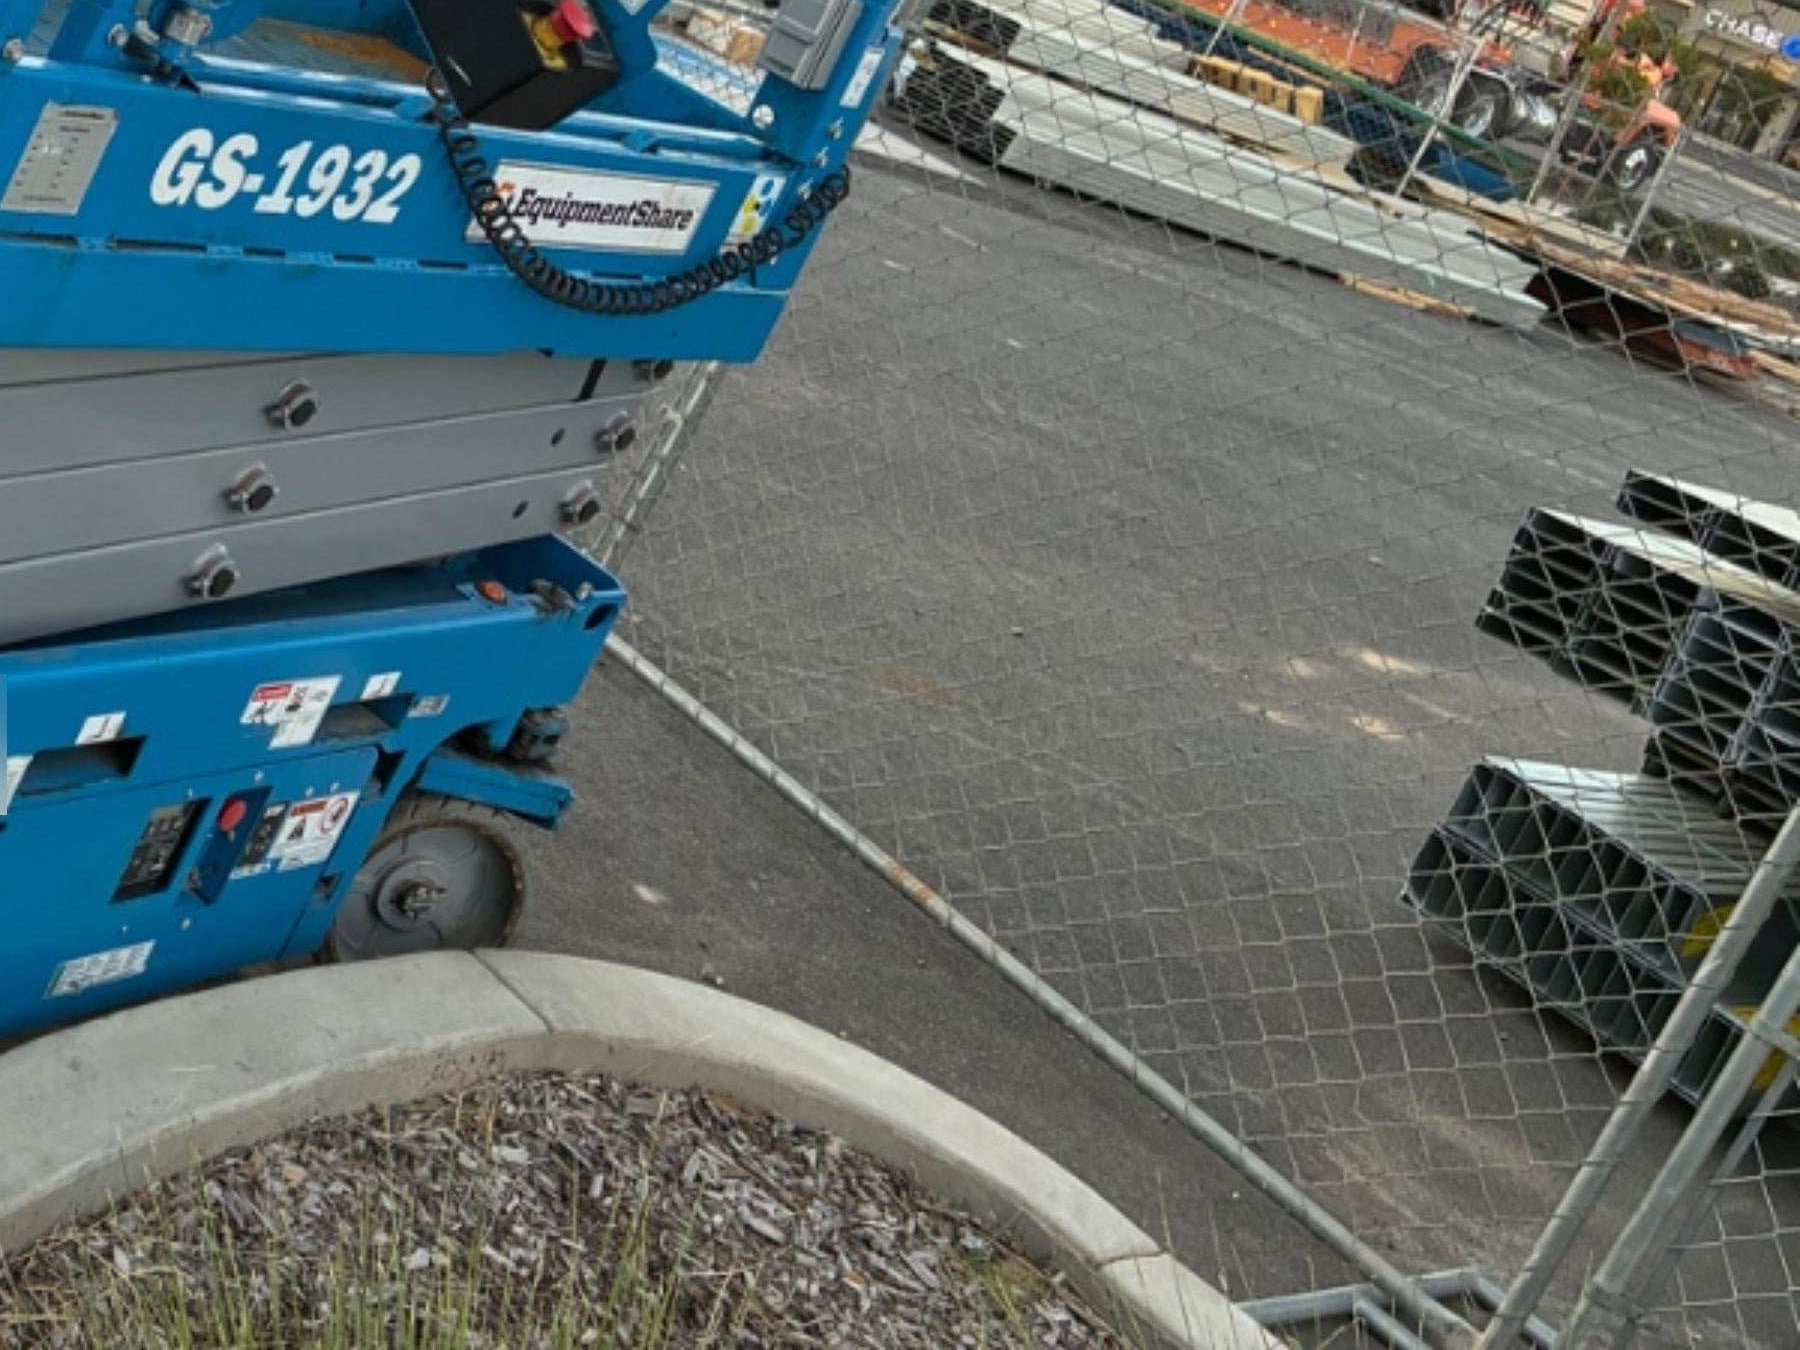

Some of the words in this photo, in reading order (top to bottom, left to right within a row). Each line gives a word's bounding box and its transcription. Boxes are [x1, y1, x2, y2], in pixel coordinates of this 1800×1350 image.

[1705, 9, 1783, 51] CHASE
[150, 127, 422, 224] GS-1932
[515, 187, 694, 231] EquipmentShare
